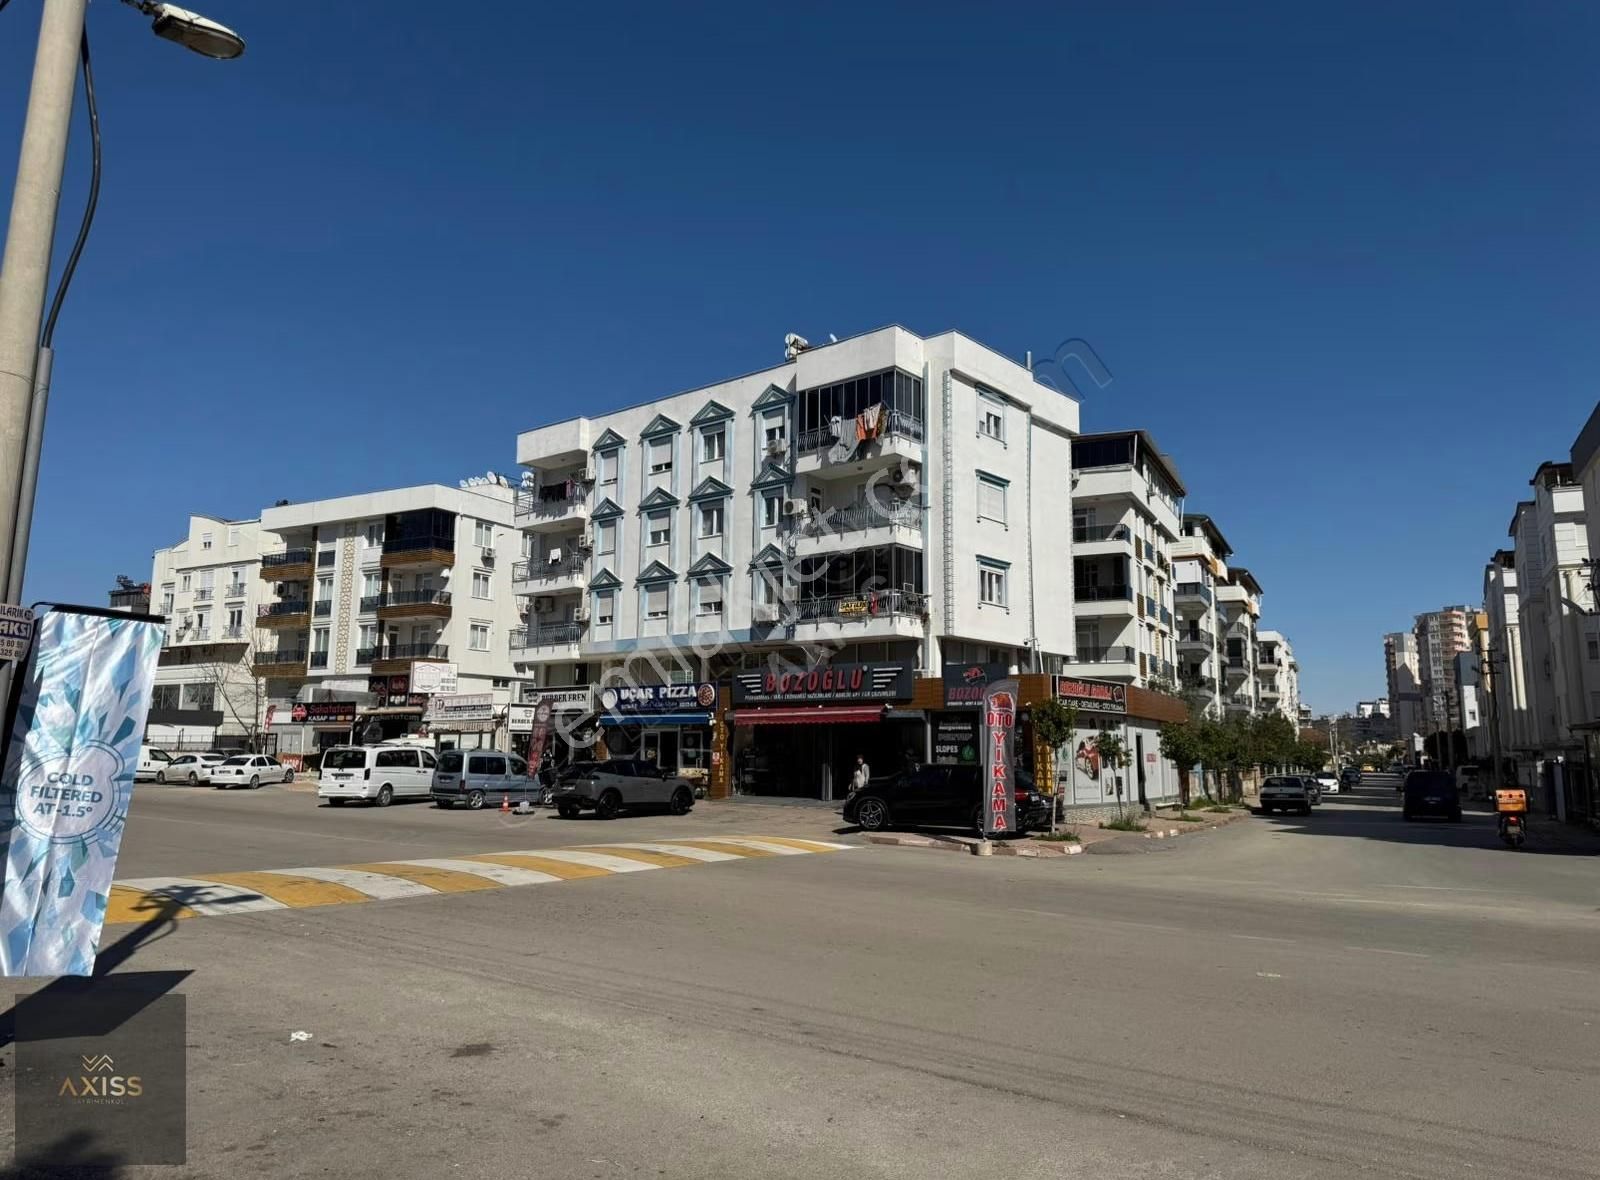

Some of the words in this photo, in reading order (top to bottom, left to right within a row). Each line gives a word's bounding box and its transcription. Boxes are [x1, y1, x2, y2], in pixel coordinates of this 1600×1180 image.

[765, 665, 864, 692] BOZOĞLU
[620, 687, 654, 703] UÇAR
[985, 711, 1014, 728] OTO
[47, 772, 94, 786] COLD
[992, 731, 1007, 830] YIKAMA
[30, 785, 103, 803] FILTERED
